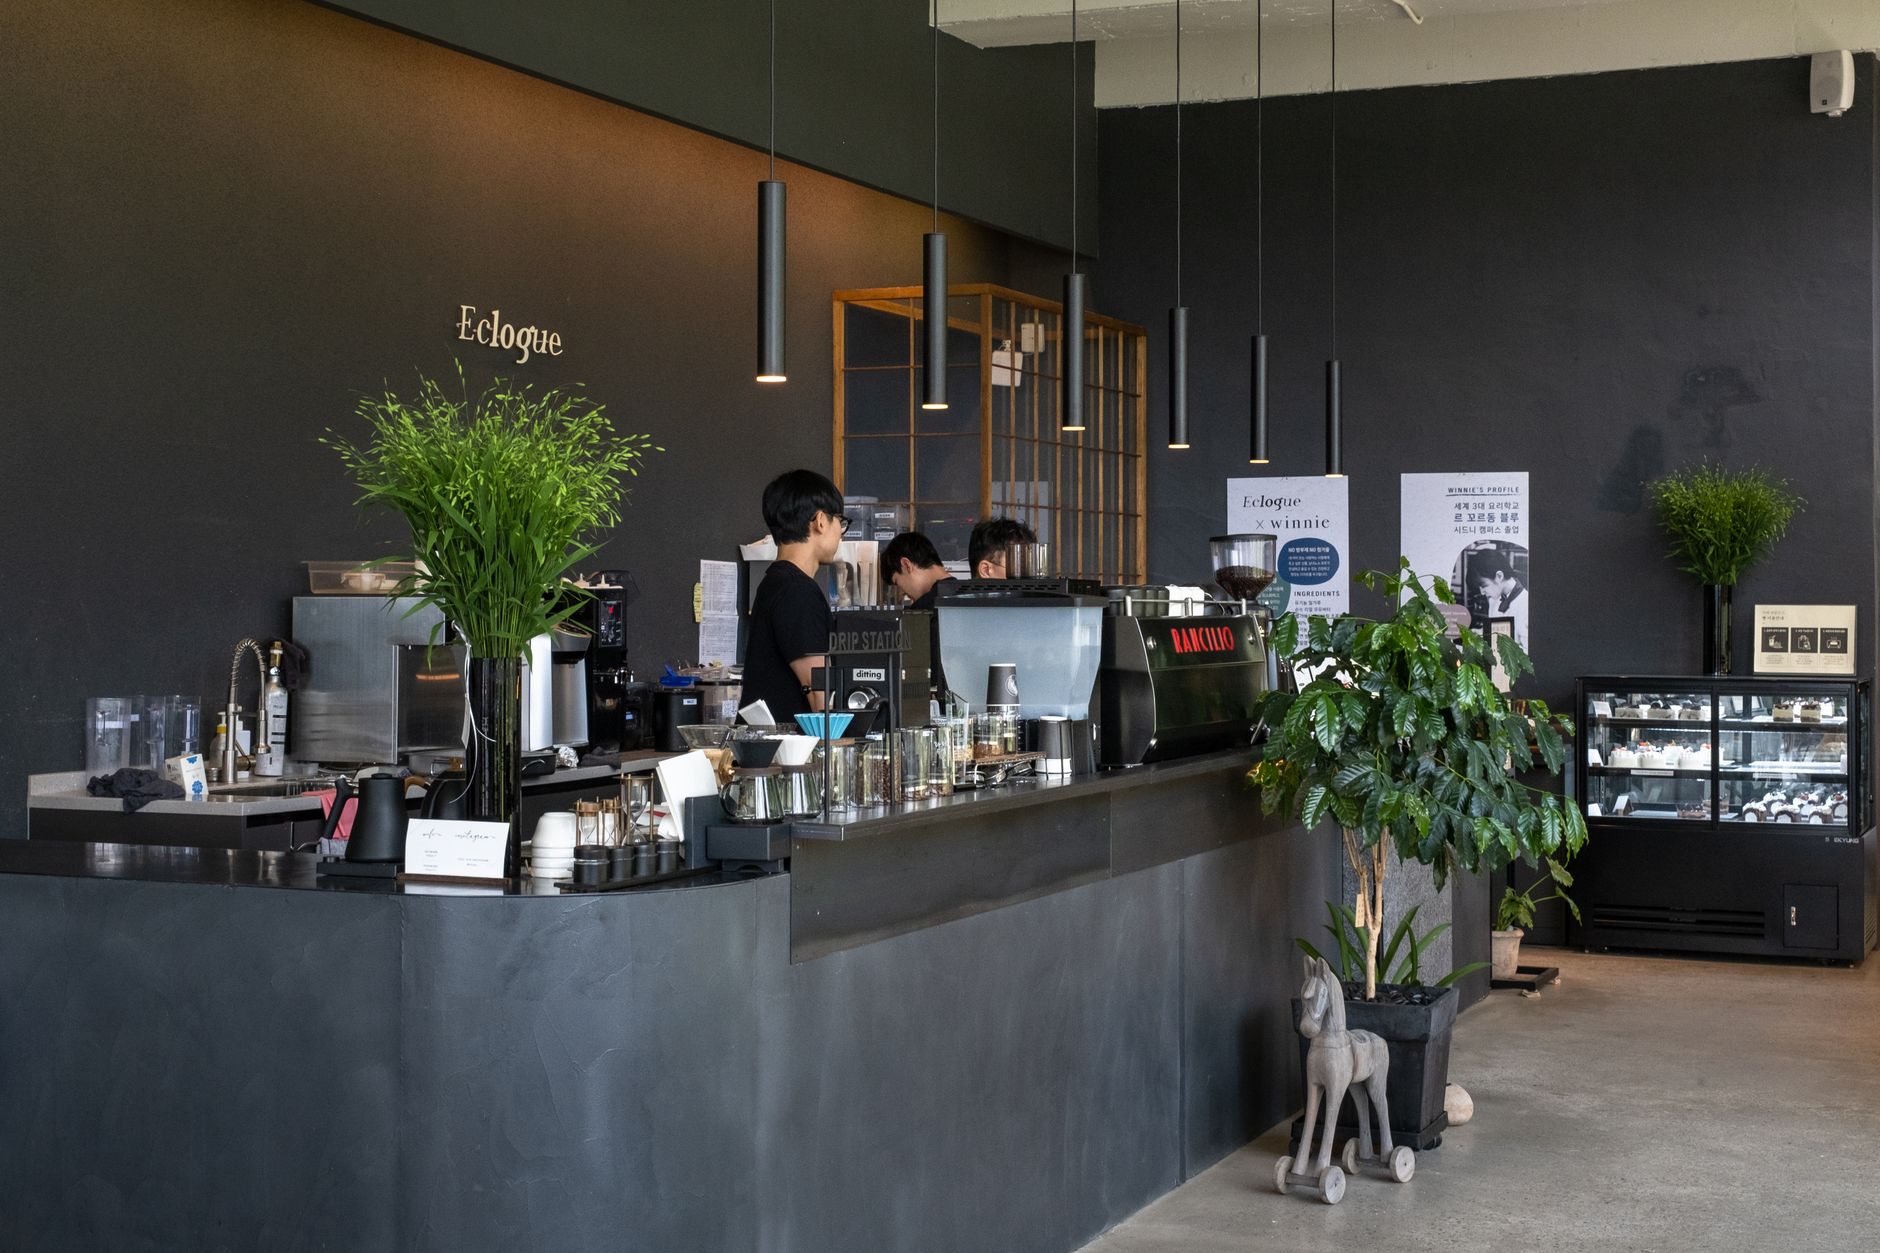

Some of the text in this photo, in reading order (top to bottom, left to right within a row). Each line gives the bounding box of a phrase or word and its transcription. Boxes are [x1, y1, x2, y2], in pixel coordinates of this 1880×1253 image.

[459, 305, 563, 364] Eclogue
[1243, 495, 1301, 511] Eclogue
[1454, 502, 1520, 510] 세계 3대 요리학교
[1271, 515, 1330, 528] winnie
[1454, 513, 1519, 523] 르 꼬르동 블루
[1454, 526, 1477, 534] 시드니
[829, 630, 912, 651] DRIP STATION
[1171, 626, 1234, 653] RANCILIO
[856, 670, 882, 680] ditting
